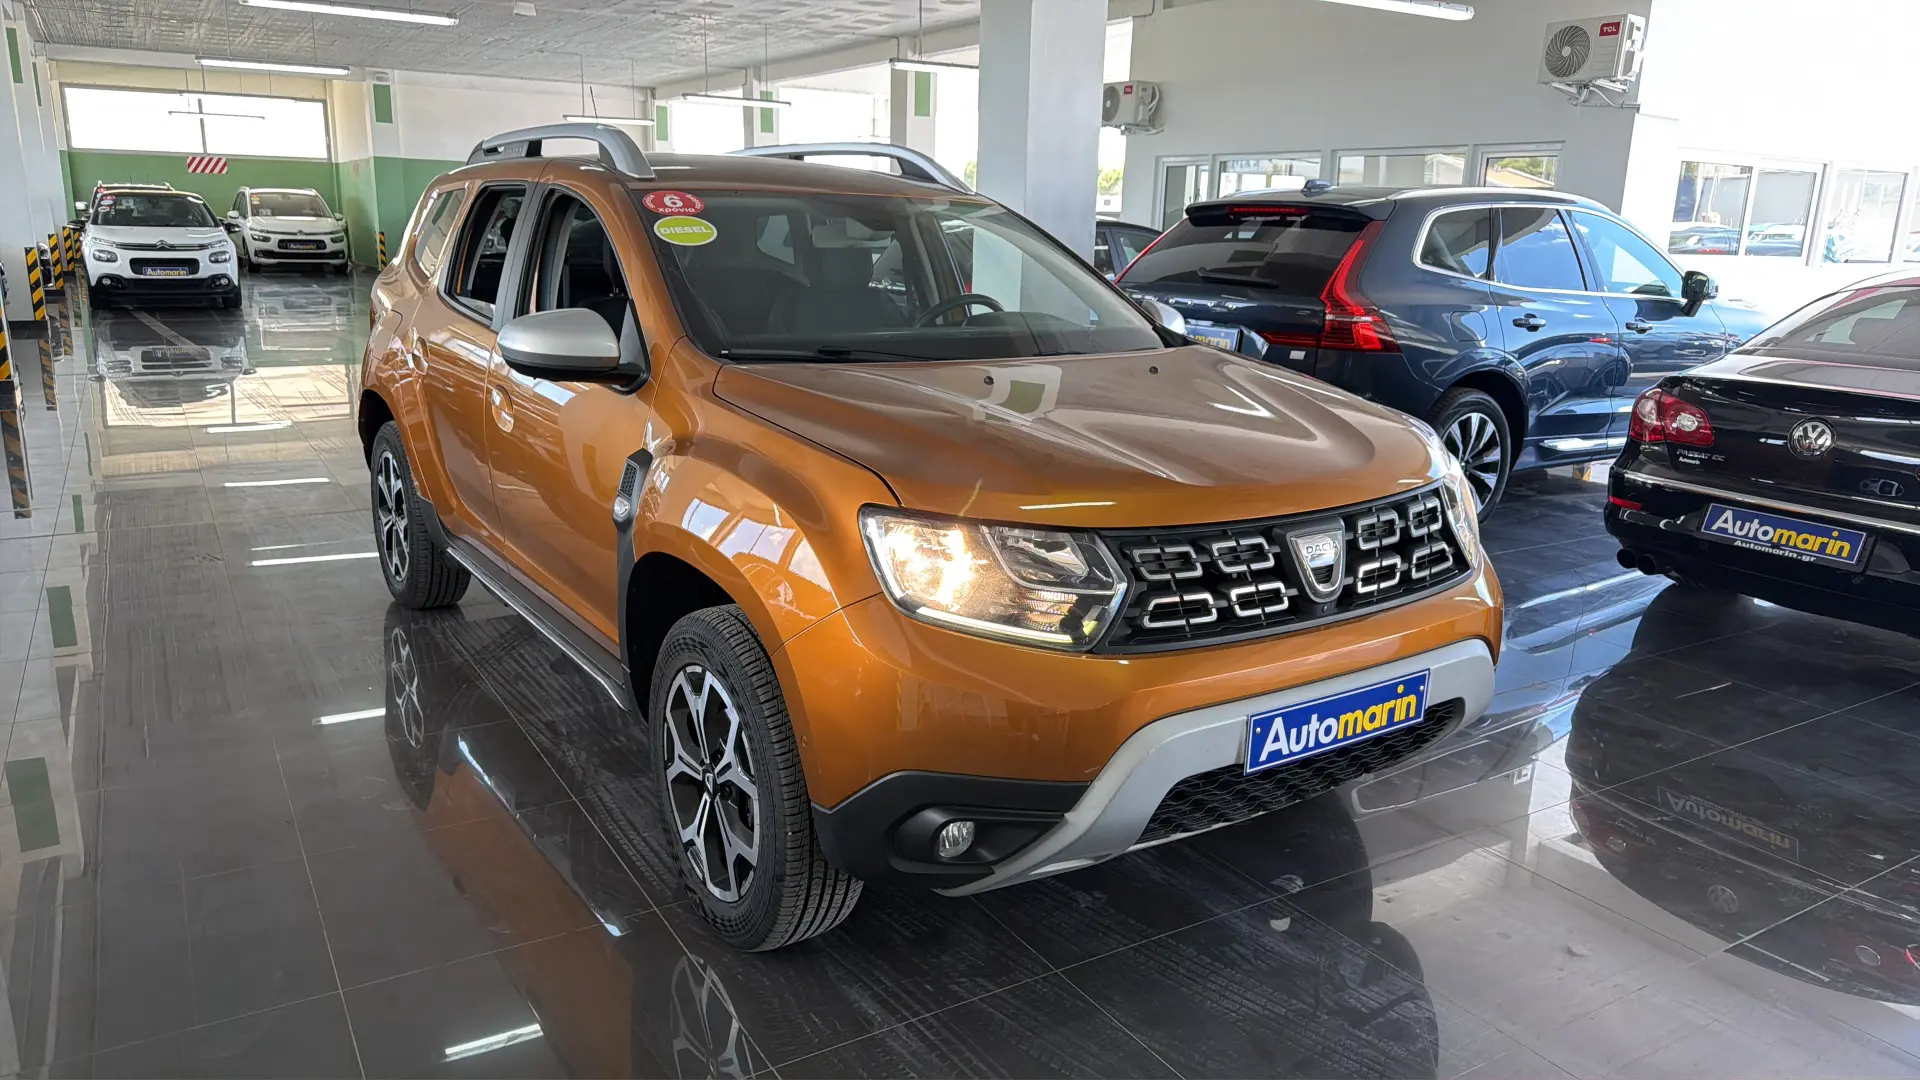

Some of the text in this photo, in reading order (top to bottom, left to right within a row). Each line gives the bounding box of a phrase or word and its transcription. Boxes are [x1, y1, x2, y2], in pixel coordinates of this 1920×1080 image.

[664, 195, 683, 208] 6
[660, 226, 711, 235] DIESEL
[146, 267, 187, 276] Automarin
[1676, 448, 1711, 459] PASSAT
[1711, 510, 1850, 558] Automarin
[1306, 541, 1339, 554] DACIA
[1734, 540, 1816, 562] Automarin.gr
[1258, 684, 1417, 762] Automarin
